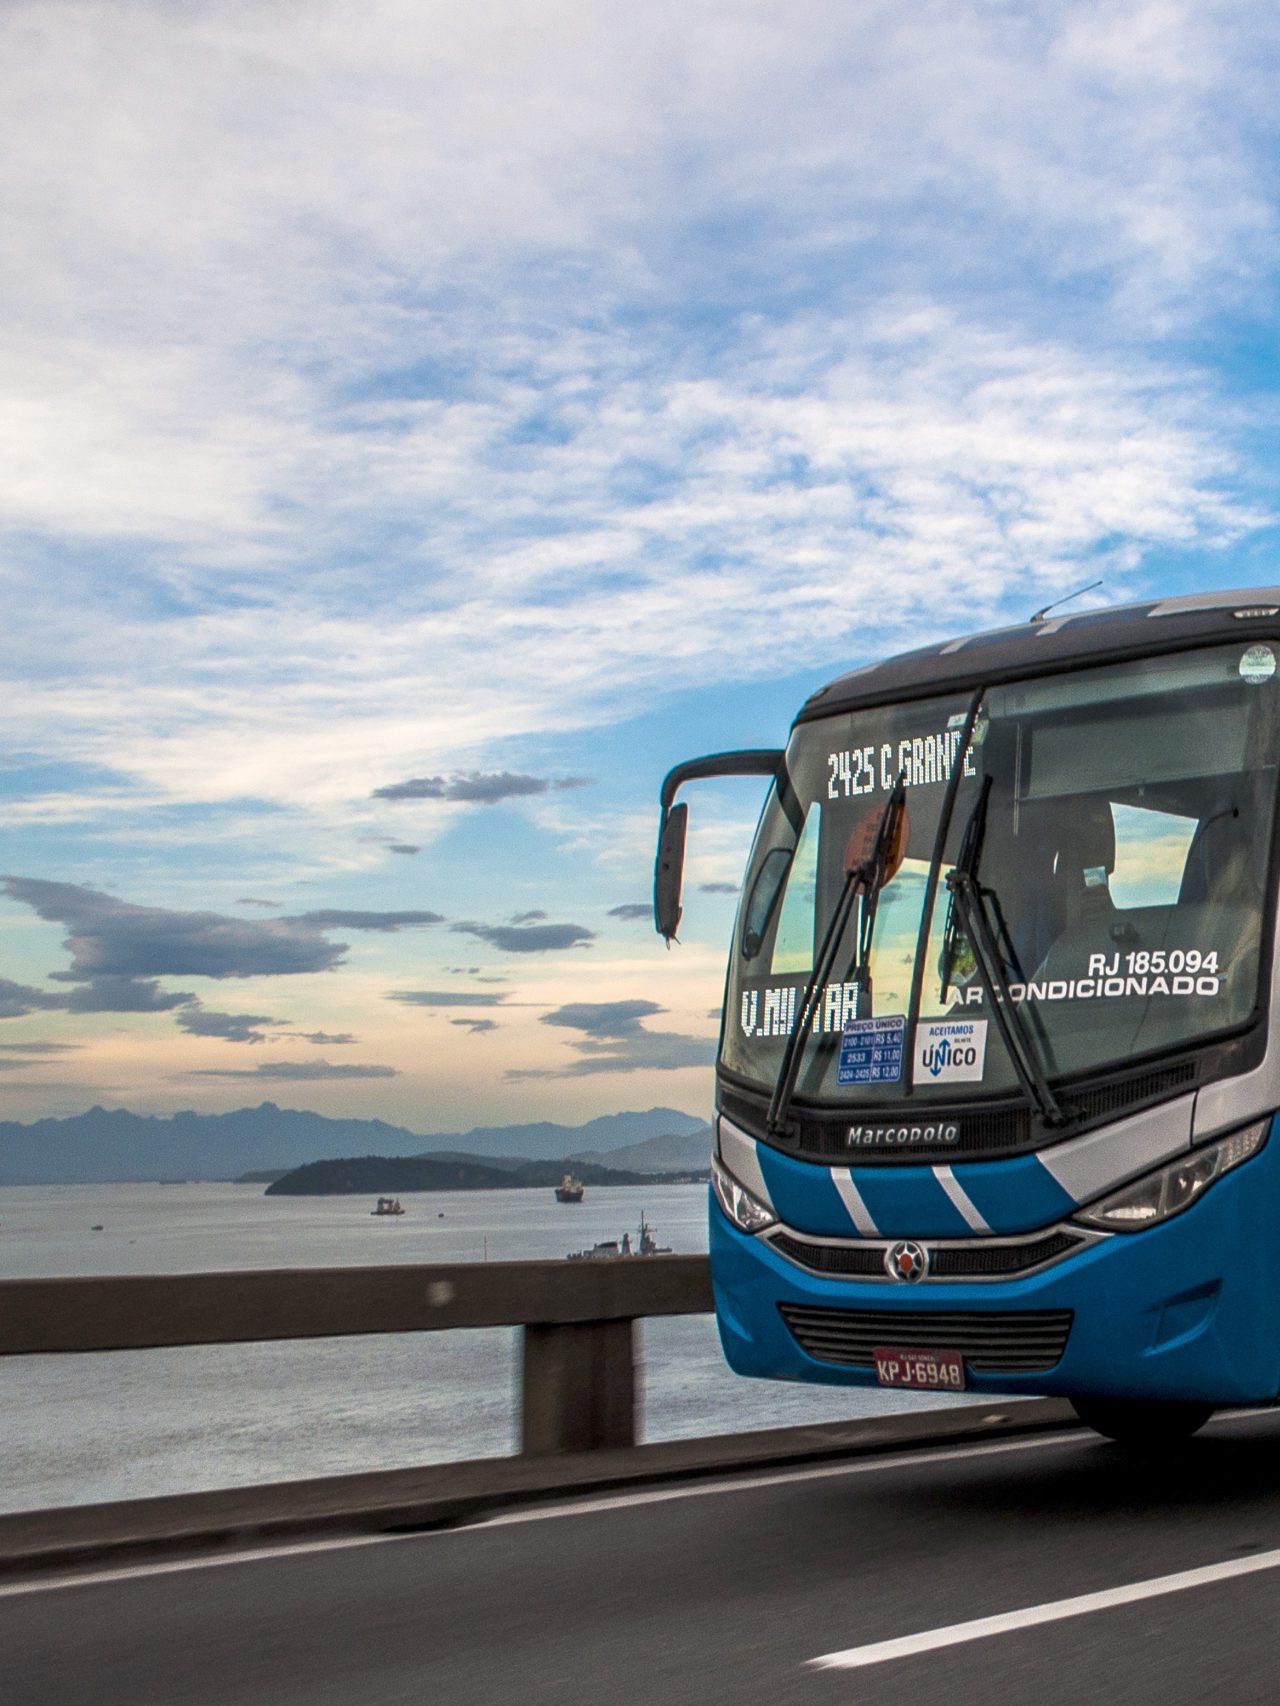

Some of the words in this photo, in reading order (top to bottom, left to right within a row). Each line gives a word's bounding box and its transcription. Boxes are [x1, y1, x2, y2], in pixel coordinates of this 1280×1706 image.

[827, 746, 875, 799] 2425
[1088, 952, 1119, 977] RJ
[1125, 950, 1219, 976] 185.094
[945, 985, 984, 1005] AR
[846, 1022, 873, 1033] PREÇO
[875, 1018, 902, 1030] ÚNICO
[929, 1025, 974, 1037] ACEITAMOS
[847, 1053, 866, 1063] 2533
[922, 1042, 977, 1069] ÚNICO
[847, 1123, 957, 1145] Marcopolo
